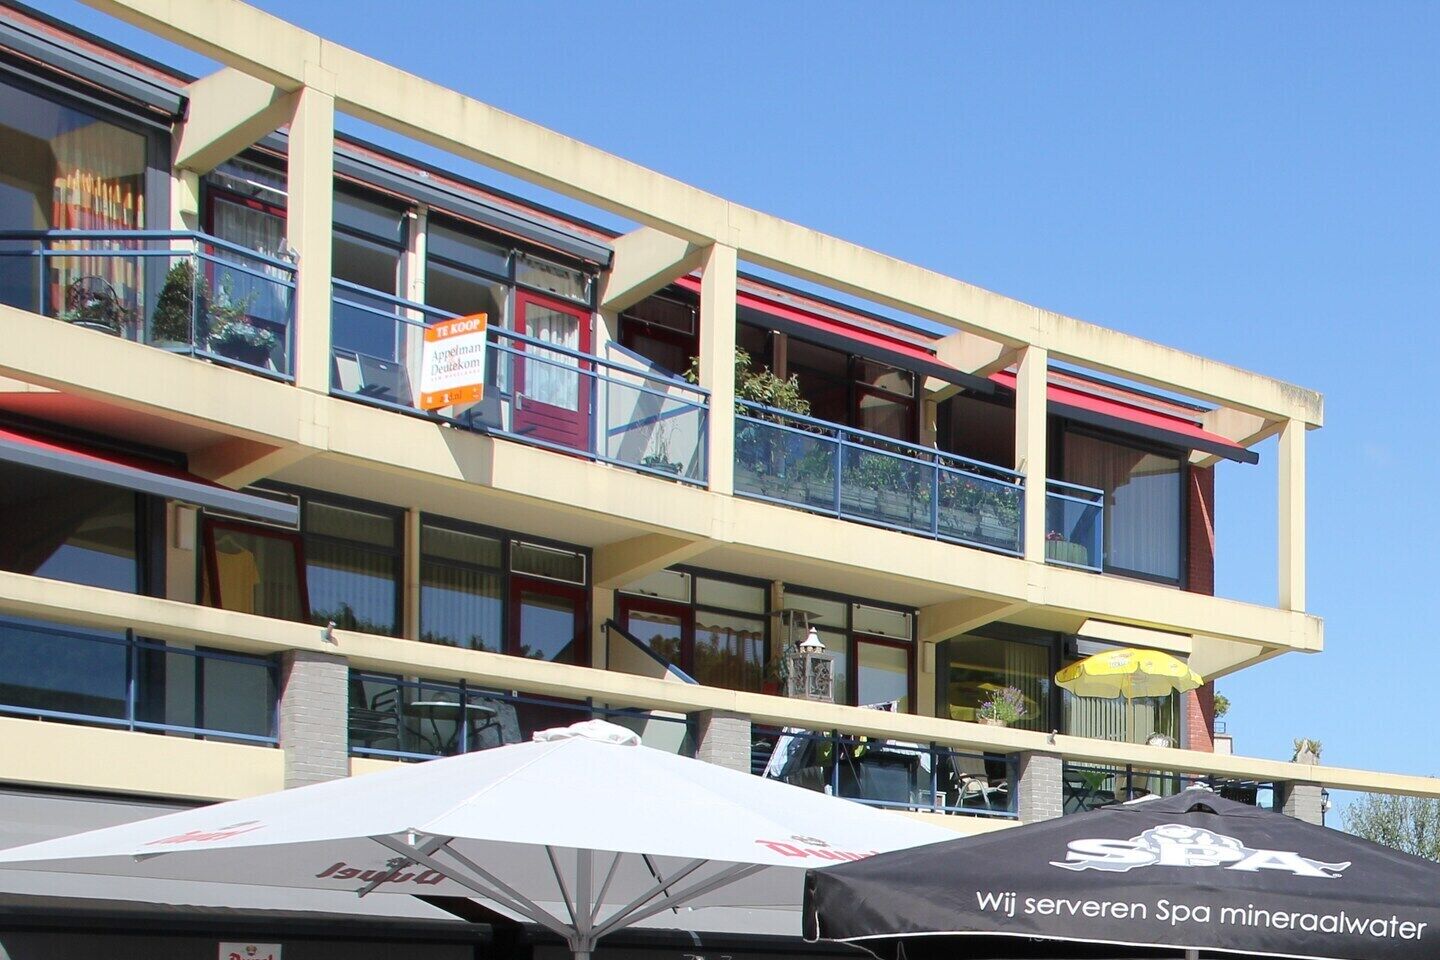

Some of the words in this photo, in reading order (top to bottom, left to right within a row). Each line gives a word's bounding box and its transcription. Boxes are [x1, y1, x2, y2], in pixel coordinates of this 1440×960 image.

[436, 326, 449, 338] TE
[450, 318, 481, 334] KOOP
[432, 343, 481, 363] Appelman
[1066, 837, 1336, 879] SPA
[976, 891, 1017, 918] Wij
[1024, 897, 1148, 920] serveren
[1155, 899, 1211, 926] Spa
[1219, 903, 1428, 940] mineraalwater
